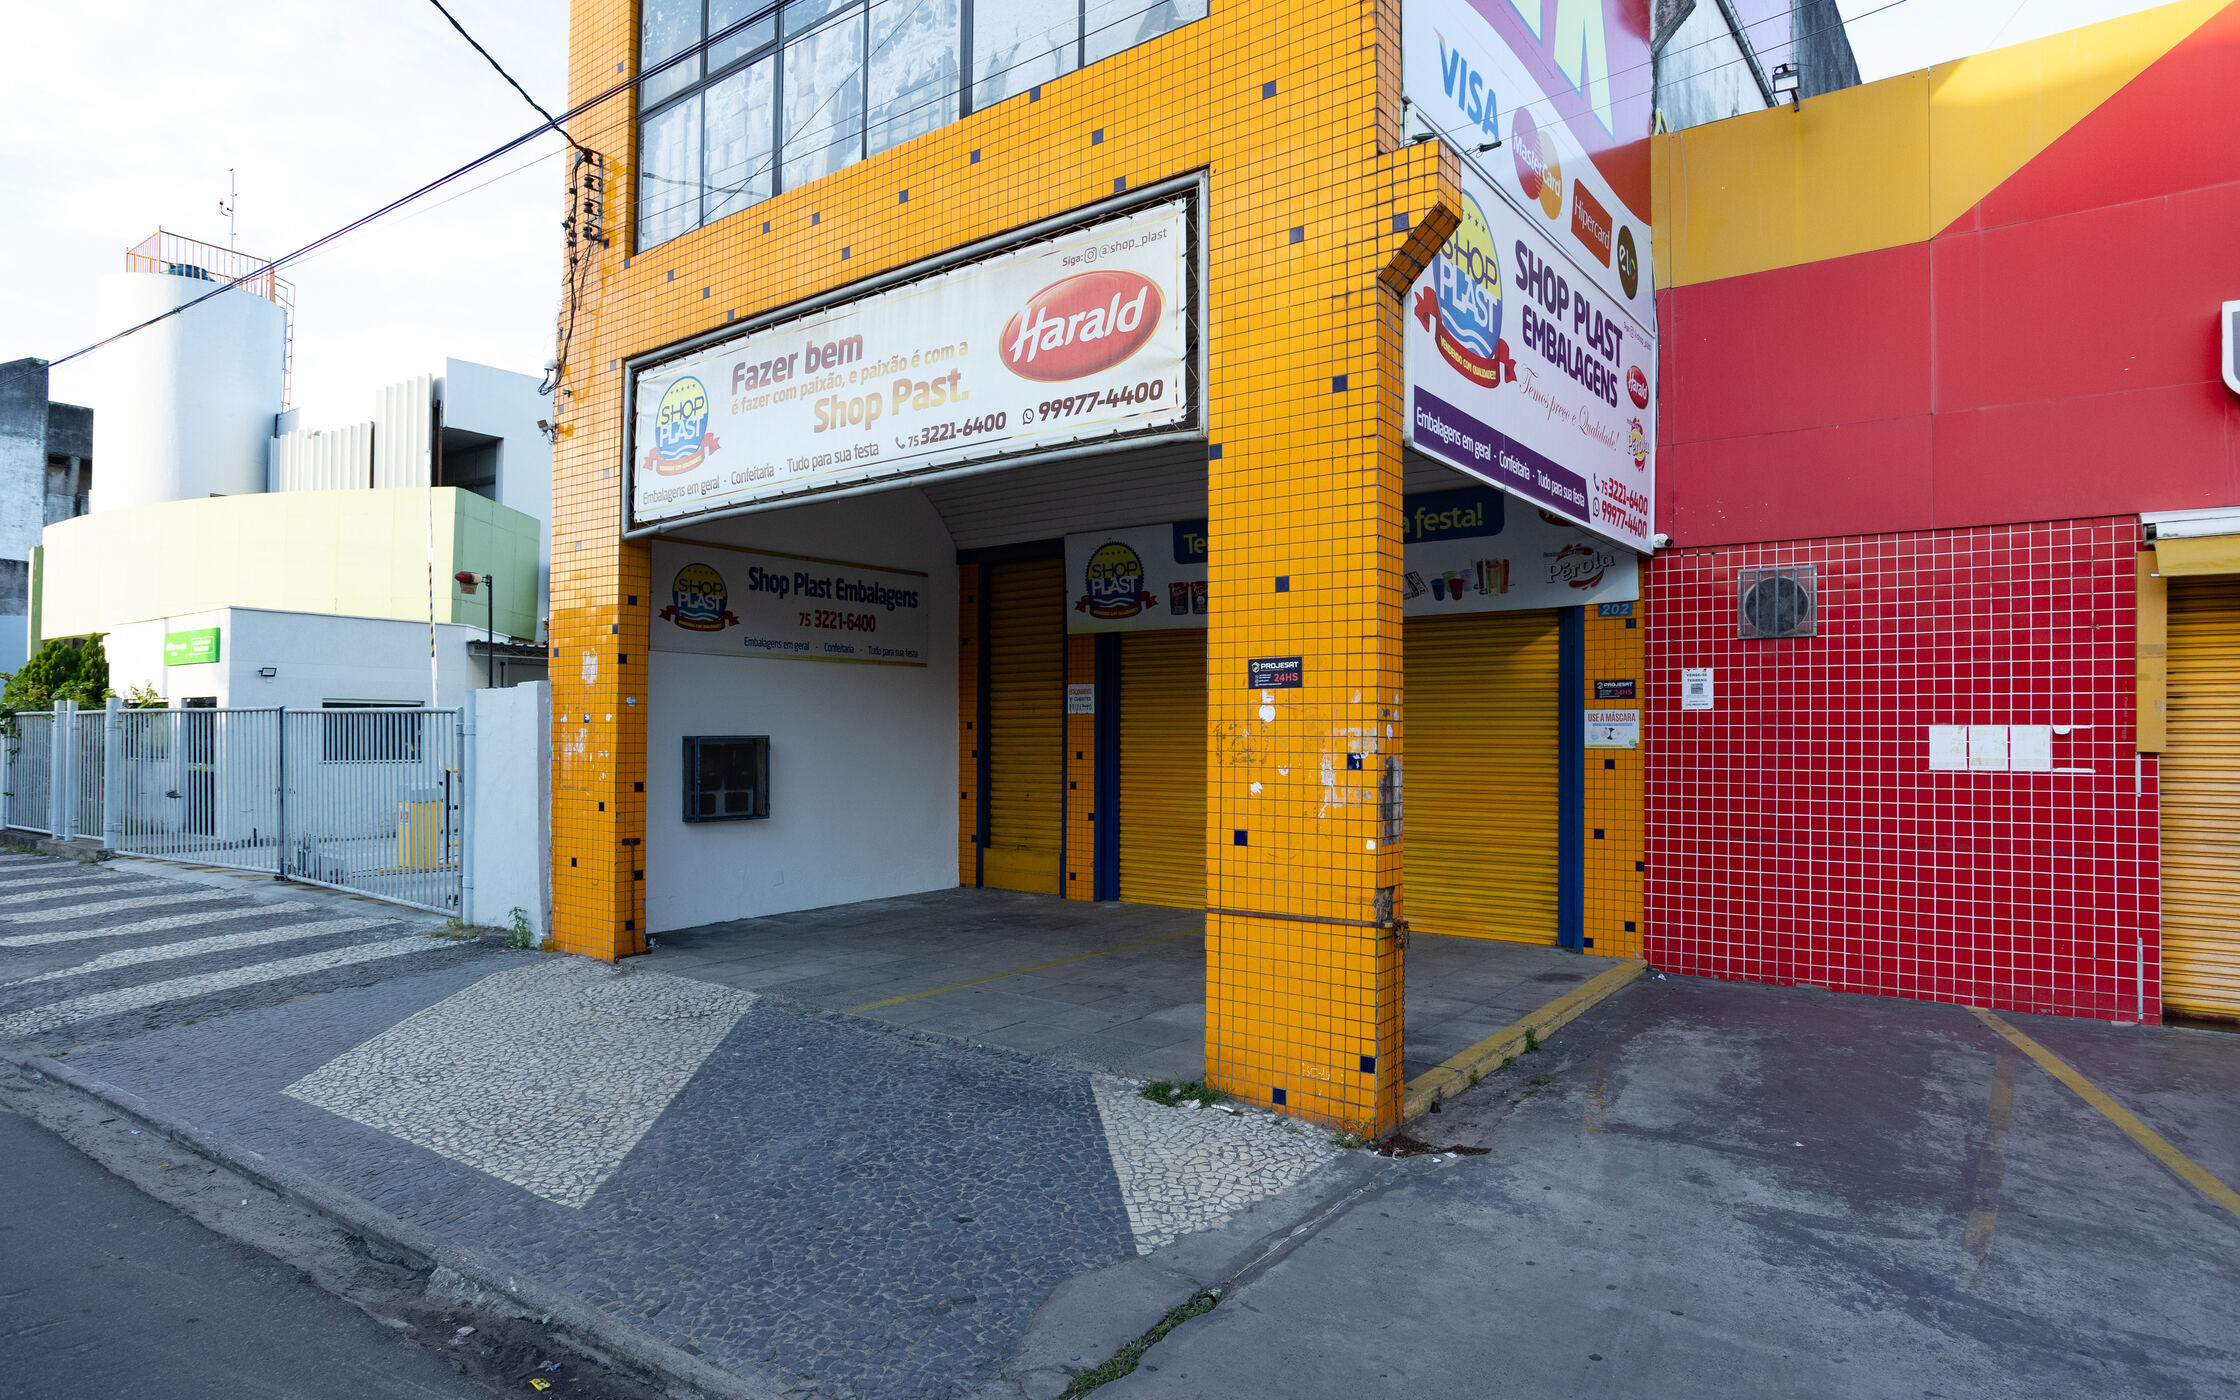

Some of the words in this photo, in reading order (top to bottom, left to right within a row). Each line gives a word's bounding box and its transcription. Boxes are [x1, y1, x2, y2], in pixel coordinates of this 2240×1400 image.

[1434, 26, 1499, 142] VISA
[1513, 134, 1561, 198] MasterCard
[1574, 195, 1610, 249] Hipercard
[1062, 253, 1084, 268] Siga:
[1099, 228, 1168, 258] @shop_plast
[1440, 256, 1498, 333] PLAST
[1515, 239, 1569, 321] SHOP
[1574, 290, 1623, 368] PLAST
[1009, 285, 1148, 363] Harald
[731, 351, 799, 396] Fazer
[804, 333, 864, 375] bem
[1522, 304, 1618, 408] EMBALAGENS
[731, 399, 739, 415] é
[742, 393, 770, 412] fazer
[772, 385, 797, 404] com
[800, 371, 846, 401] paixão,
[849, 369, 857, 384] e
[860, 354, 908, 385] paixão
[911, 349, 921, 368] é
[924, 344, 955, 366] com
[958, 341, 969, 356] a
[1519, 363, 1549, 409] Temos
[1547, 396, 1570, 422] preço
[1572, 414, 1577, 423] e
[661, 396, 705, 425] SHOP
[813, 392, 883, 434] Shop
[892, 367, 970, 417] Past.
[1038, 379, 1164, 422] 99977-4400
[659, 414, 705, 448] PLAST
[907, 435, 919, 449] 75
[920, 411, 1007, 446] 3221-6400
[642, 484, 686, 505] Embalagens
[687, 483, 699, 496] em
[701, 474, 720, 496] geral
[730, 463, 775, 486] Confeitaria
[787, 455, 810, 473] Tudo
[812, 452, 832, 472] para
[834, 447, 852, 463] sua
[854, 442, 879, 460] festa
[1416, 406, 1461, 446] Embalagens
[1462, 433, 1474, 453] em
[1474, 440, 1491, 461] geral
[1499, 450, 1530, 481] Confeitaria
[1537, 469, 1550, 491] Tudo
[1551, 481, 1562, 497] para
[1563, 485, 1573, 501] sua
[1573, 487, 1585, 508] festa
[1601, 479, 1608, 496] 75
[1608, 477, 1648, 516] 3221-6400
[1414, 502, 1484, 539] festa!
[1602, 500, 1648, 540] 99977-4400
[1183, 532, 1208, 555] Te
[678, 577, 723, 596] SHOP
[1091, 560, 1139, 579] SHOP
[1091, 575, 1139, 596] PLAST
[1544, 551, 1615, 584] Pérola
[677, 591, 723, 611] PLAST
[748, 566, 789, 599] Shop
[793, 571, 832, 600] Plast
[835, 578, 919, 611] Embalagens
[799, 612, 811, 628] 75
[814, 609, 876, 633] 3221-6400
[1600, 603, 1630, 616] 202
[744, 636, 782, 650] Embalagens
[783, 642, 793, 650] em
[794, 641, 810, 652] geral
[868, 645, 881, 656] Tudo
[1261, 661, 1299, 669] PROJESAT
[1274, 672, 1299, 682] 24HS
[1588, 713, 1600, 722] USE
[1600, 713, 1605, 722] A
[1605, 711, 1636, 722] MÁSCARA
